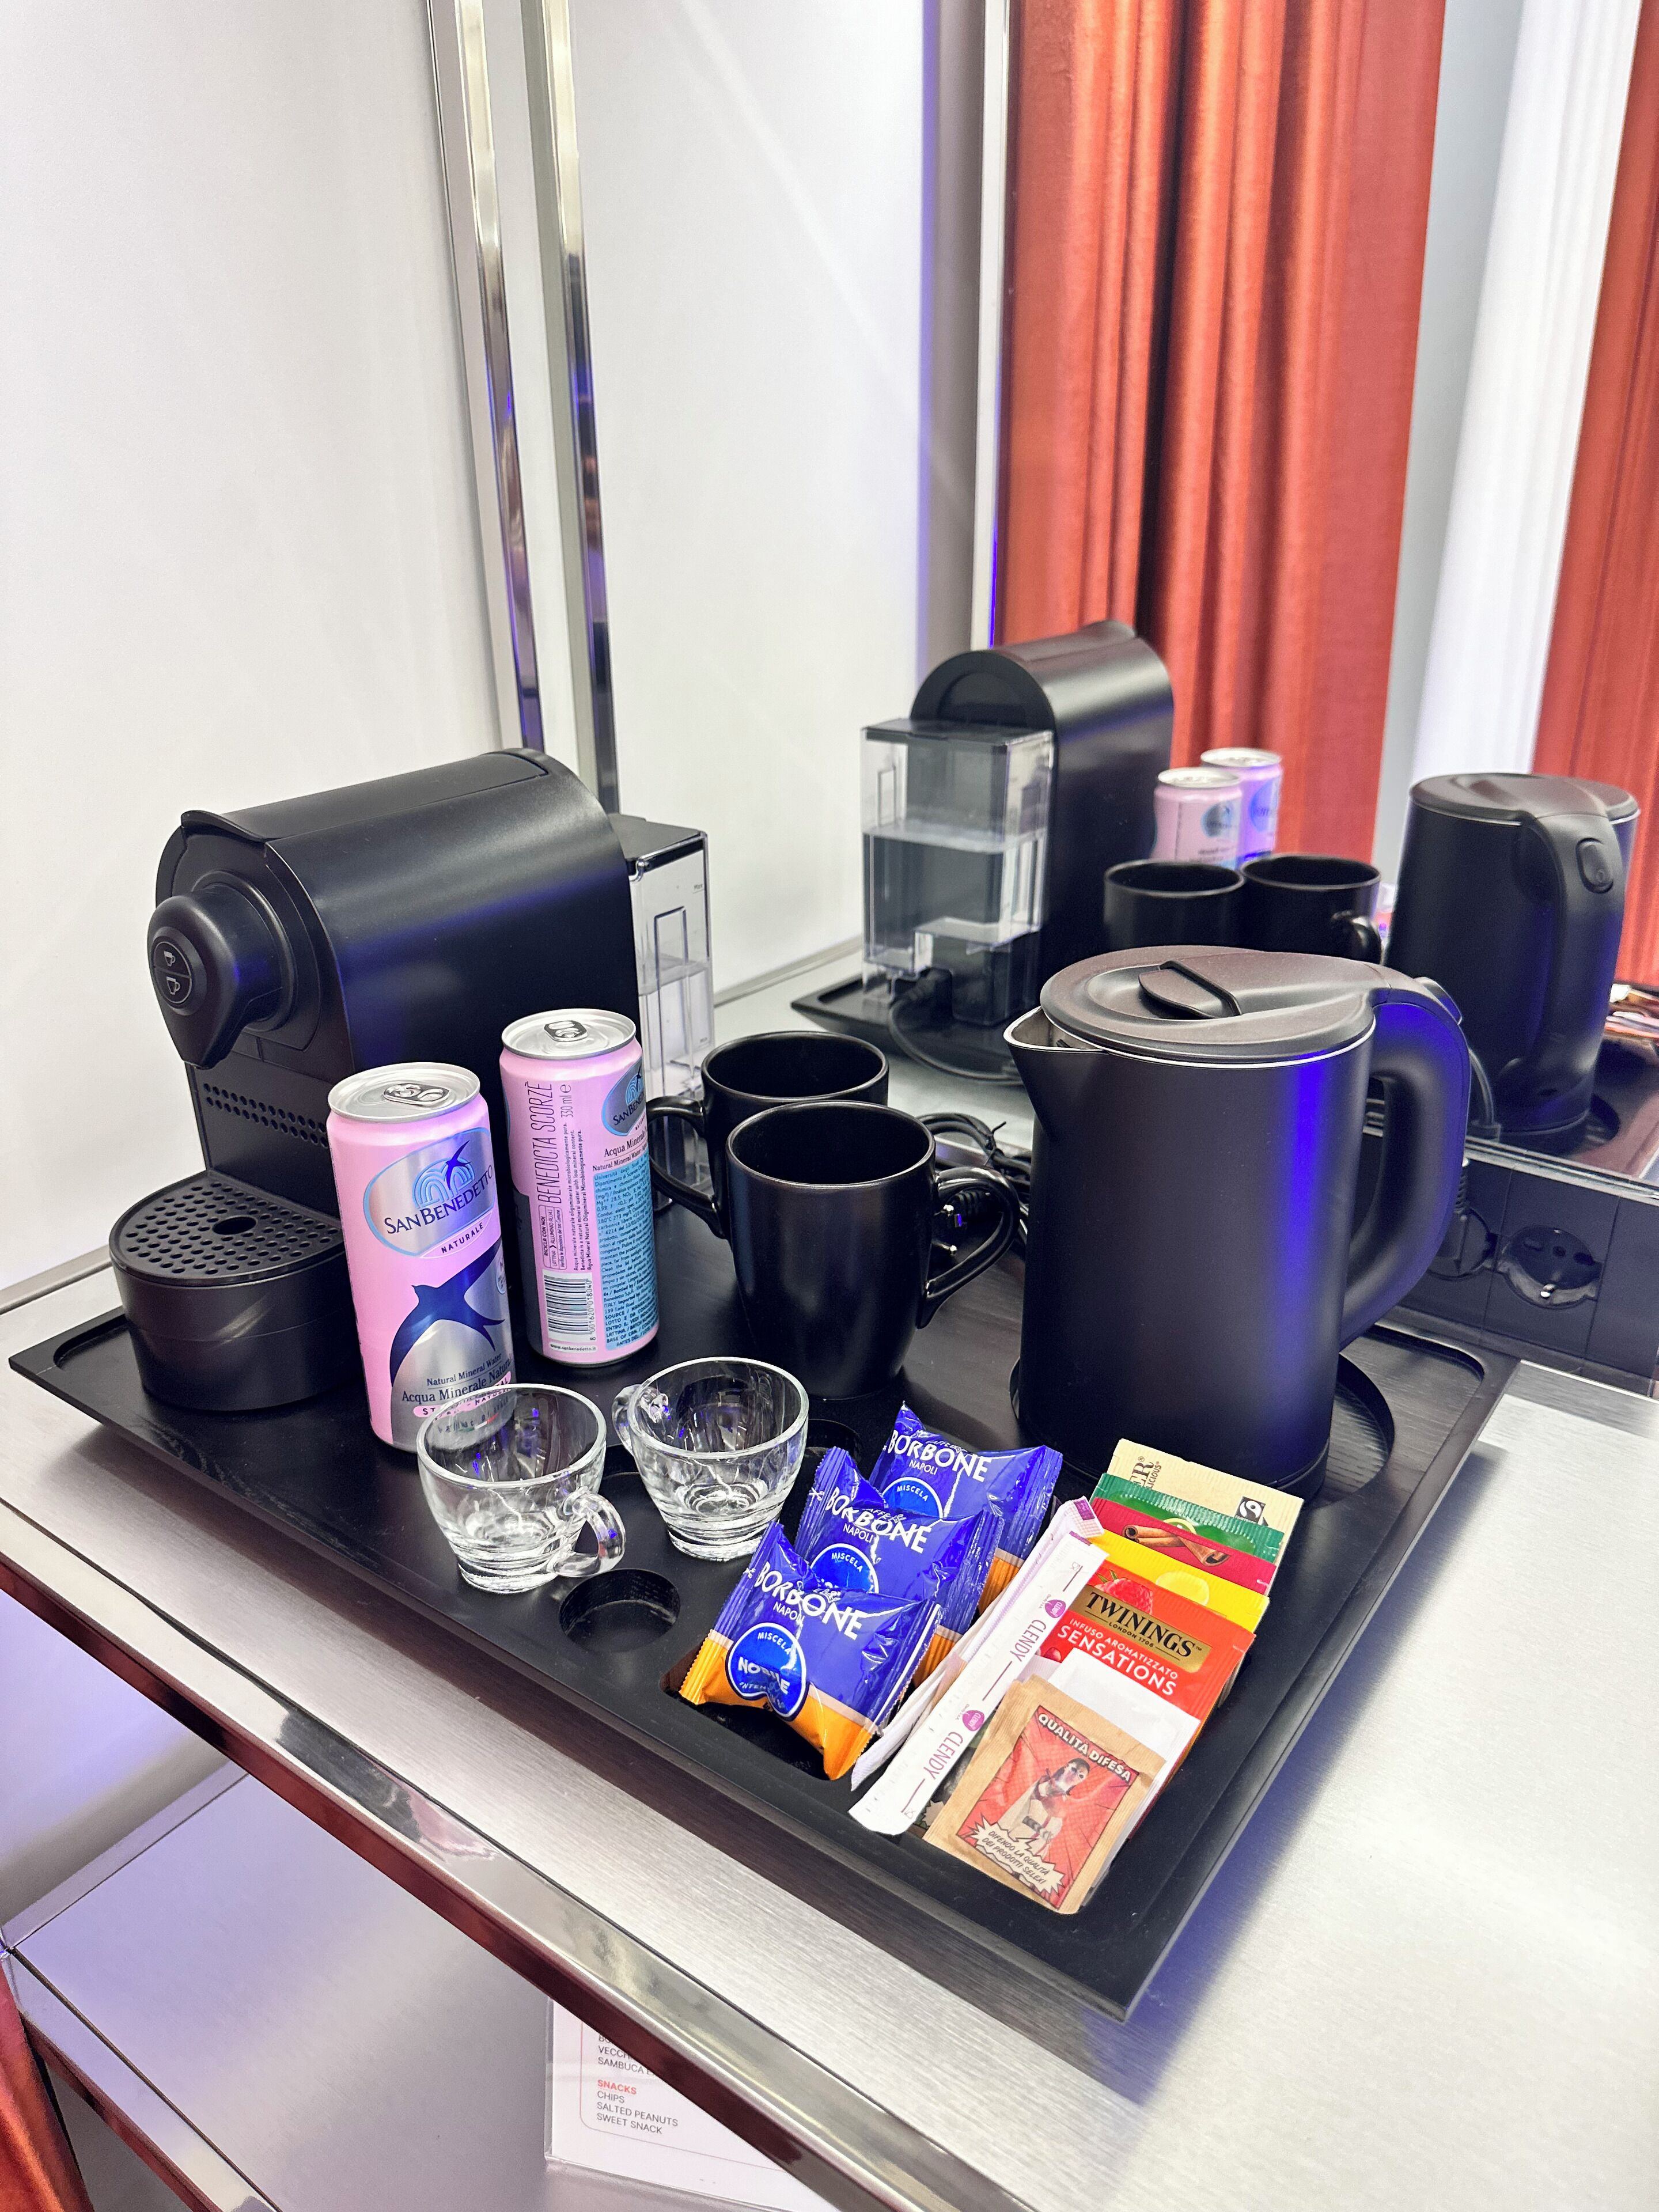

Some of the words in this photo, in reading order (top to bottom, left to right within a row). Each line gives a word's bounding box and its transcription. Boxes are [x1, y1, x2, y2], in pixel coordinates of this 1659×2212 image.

[525, 1081, 555, 1131] SCORZÈ
[559, 1096, 572, 1104] ml
[560, 1107, 573, 1118] 330
[593, 1161, 612, 1171] Natural
[614, 1154, 631, 1165] Mineral
[605, 1145, 626, 1157] Acqua
[532, 1137, 562, 1203] BENEDICTA
[441, 1222, 483, 1253] NATURALE
[427, 1373, 456, 1386] Natural
[459, 1363, 485, 1379] Mineral
[486, 1353, 502, 1368] Water
[402, 1391, 435, 1405] Acqua
[440, 1378, 487, 1400] Minerale
[887, 1429, 993, 1483] BORBONE
[909, 1460, 938, 1475] NAPOLI
[897, 1484, 929, 1502] MISCELA
[825, 1487, 932, 1554] BORBONE
[843, 1522, 874, 1543] NAPOLI
[831, 1552, 863, 1573] MISCELA
[754, 1561, 868, 1641] BORBONE
[1086, 1592, 1195, 1657] TWININGS
[1109, 1622, 1137, 1639] LONDON
[757, 1632, 791, 1654] MISCELA
[1010, 1620, 1046, 1662] CLENDY
[1070, 1618, 1104, 1639] INFUSO
[1104, 1637, 1178, 1680] AROMATIZZATO
[1057, 1624, 1177, 1696] SENSATIONS
[923, 1732, 963, 1779] CLENDY
[1089, 1749, 1131, 1782] DIFESA
[982, 1838, 994, 1847] DEI
[994, 1846, 1023, 1868] PRODOTTI
[988, 1831, 1016, 1851] DIFENDO
[598, 2056, 643, 2074] SAMBUCA
[597, 2080, 637, 2094] SNACKS
[597, 2090, 624, 2103] CHIPS
[597, 2102, 632, 2116] SALTED
[635, 2111, 678, 2127] PEANUTS
[597, 2113, 628, 2126] SWEET
[630, 2120, 662, 2134] SNACK
